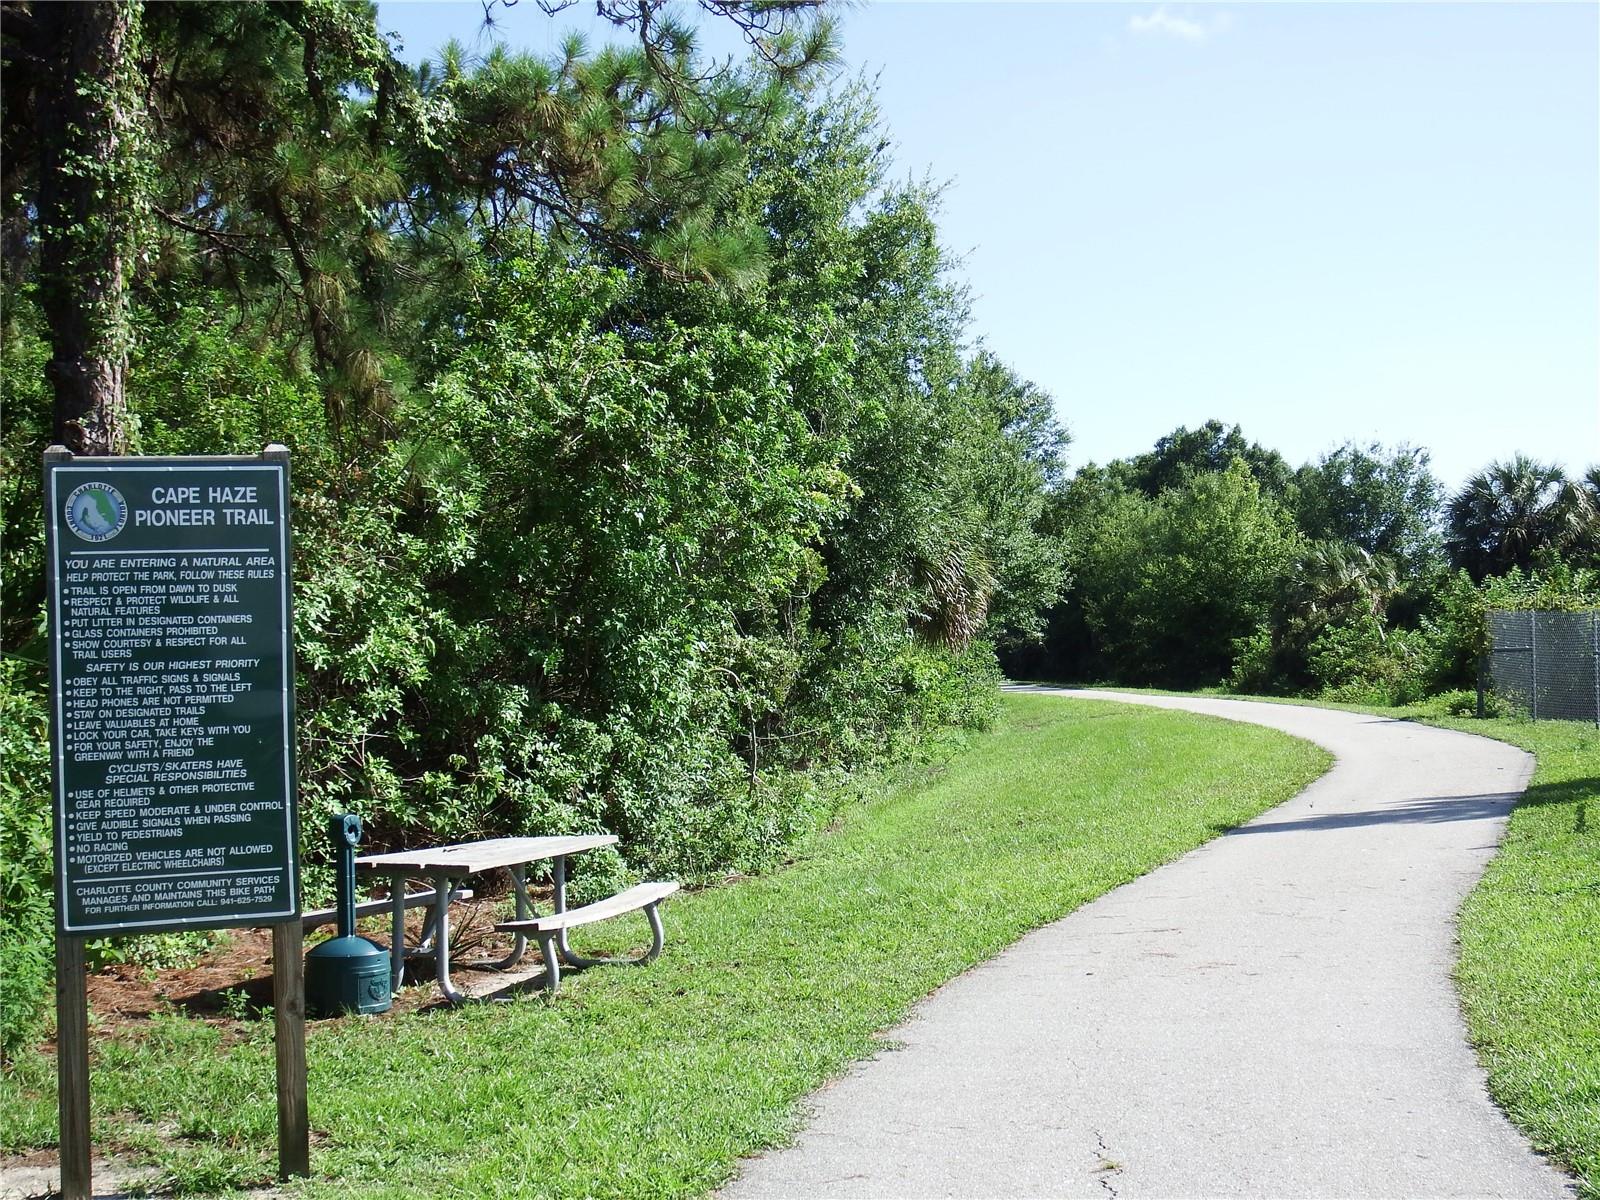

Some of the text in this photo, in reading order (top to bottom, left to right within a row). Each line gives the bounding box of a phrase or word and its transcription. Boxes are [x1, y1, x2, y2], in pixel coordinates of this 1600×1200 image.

[73, 483, 115, 497] CHARLOTTE
[151, 486, 258, 504] CAPE HAZE
[135, 508, 274, 526] PIONEER TRAIL
[65, 556, 275, 569] YOU ARE ENTERING A NATURAL AREA
[66, 569, 274, 582] HELP PROTECT THE PARK, FOLLOW THESE RULES
[70, 583, 238, 595] TRAIL IS OPEN FROM DAWN TO DUSK
[71, 594, 239, 606] RESPECT & PROTECT WILDLIFE & ALL
[71, 605, 160, 616] NATURAL FEATURES
[71, 614, 252, 627] PUT LITTER IN DESIGNATED CONTAINERS
[72, 626, 218, 638] GLASS CONTAINERS PROHIBITED
[72, 636, 247, 649] SHOW COURTESY & RESPECT FOR ALL
[72, 649, 132, 659] TRAIL USERS
[85, 658, 260, 672] SAFETY IS OUR HIGHEST PRIORITY
[73, 672, 240, 686] OBEY ALL TRAFFIC SIGNS & SIGNALS
[73, 682, 252, 697] KEEP TO THE RIGHT, PASS TO THE LEFT
[73, 694, 234, 708] HEAD PHONES ARE NOT PERMITTED
[73, 706, 206, 719] STAY ON DESIGNATED TRAILS
[74, 716, 199, 730] LEAVE VALUABLES AT HOME
[74, 724, 251, 740] LOCK YOUR CAR, TAKE KEYS WITH YOU
[74, 737, 214, 752] FOR YOUR SAFETY, ENJOY THE
[74, 748, 194, 762] GREENWAY WITH A FRIEND
[108, 758, 243, 774] CYCLISTS/SKATERS HAVE
[105, 768, 247, 784] SPECIAL RESPONSIBILITIES
[75, 781, 255, 799] USE OF HELMETS & OTHER PROTECTIVE
[75, 797, 150, 809] GEAR REQUIRED
[76, 801, 284, 820] KEEP SPEED MODERATE & UNDER CONTROL
[76, 813, 251, 831] GIVE AUDIBLE SIGNALS WHEN PASSING
[76, 827, 183, 842] YIELD TO PEDESTRIANS
[76, 842, 128, 853] NO RACING
[77, 844, 273, 864] MOTORIZED VEHICLES ARE NOT ALLOWED
[84, 856, 224, 874] (EXCEPT ELECTRIC WHEELCHAIRS)
[76, 875, 280, 896] CHARLOTTE COUNTY COMMUNITY SERVICES
[82, 885, 275, 906] MANAGES AND MAINTAINS THIS BIKE PATH
[104, 904, 140, 913] FURTHER
[142, 900, 194, 910] INFORMATION
[220, 895, 272, 905] 941-625-7529
